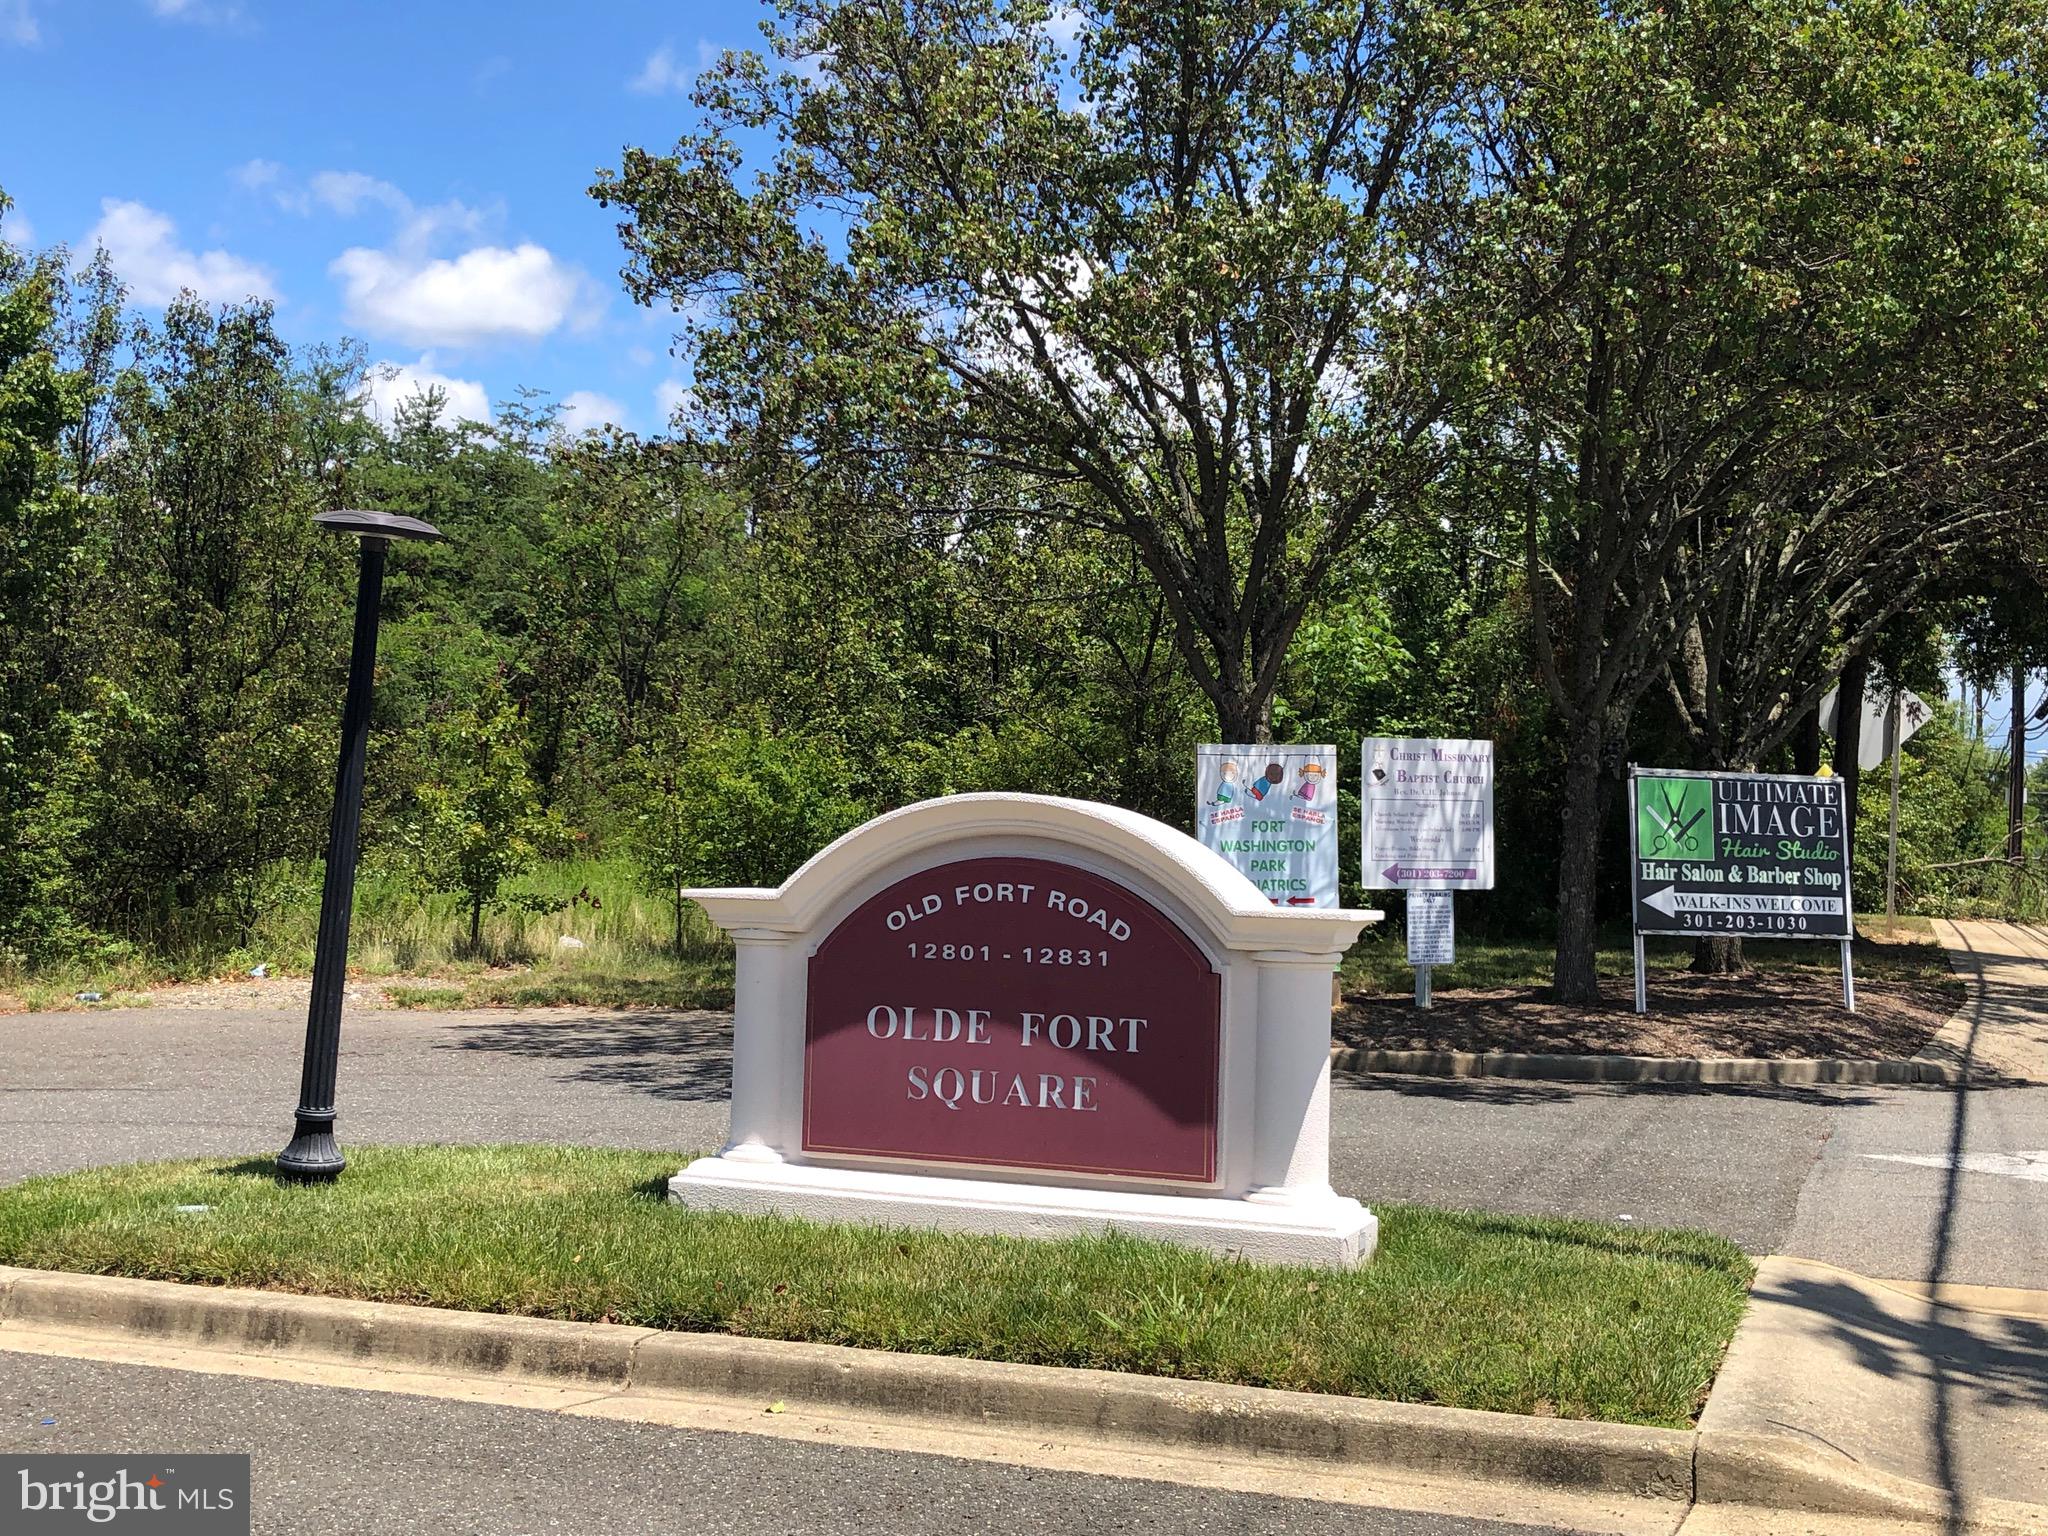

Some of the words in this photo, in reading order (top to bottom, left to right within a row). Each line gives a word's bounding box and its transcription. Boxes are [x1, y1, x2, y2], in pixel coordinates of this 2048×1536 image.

[1390, 748, 1427, 760] CHRIST
[1431, 748, 1490, 763] MISSIONARY
[1397, 770, 1440, 783] BAPTIST
[1444, 770, 1484, 784] CHURCH
[1718, 781, 1838, 805] ULTIMATE
[1220, 807, 1244, 818] HABLA
[1303, 809, 1326, 818] HABLA
[1718, 803, 1840, 838] IMAGE
[1252, 821, 1285, 832] FORT
[1220, 840, 1315, 852] WASHINGTON
[1722, 838, 1770, 858] Hair
[1776, 840, 1840, 861] Studio
[1251, 860, 1286, 871] PARK
[1396, 869, 1422, 878] (301)
[1424, 870, 1464, 878] 203-7200
[1641, 863, 1677, 880] Hair
[1682, 865, 1724, 882] Salon
[1728, 865, 1742, 883] &
[1747, 866, 1800, 885] Barber
[1805, 868, 1841, 890] Shop
[887, 894, 942, 932] OLD
[955, 883, 1035, 906] FORT
[1048, 889, 1132, 941] ROAD
[1674, 896, 1751, 909] WALK-INS
[1756, 897, 1836, 912] WELCOME
[1684, 914, 1807, 930] 301-203-1030
[908, 943, 990, 961] 12801
[1023, 948, 1109, 967] 12831
[867, 1005, 991, 1044] OLDE
[1020, 1012, 1148, 1053] FORT
[906, 1066, 1098, 1112] SQUARE
